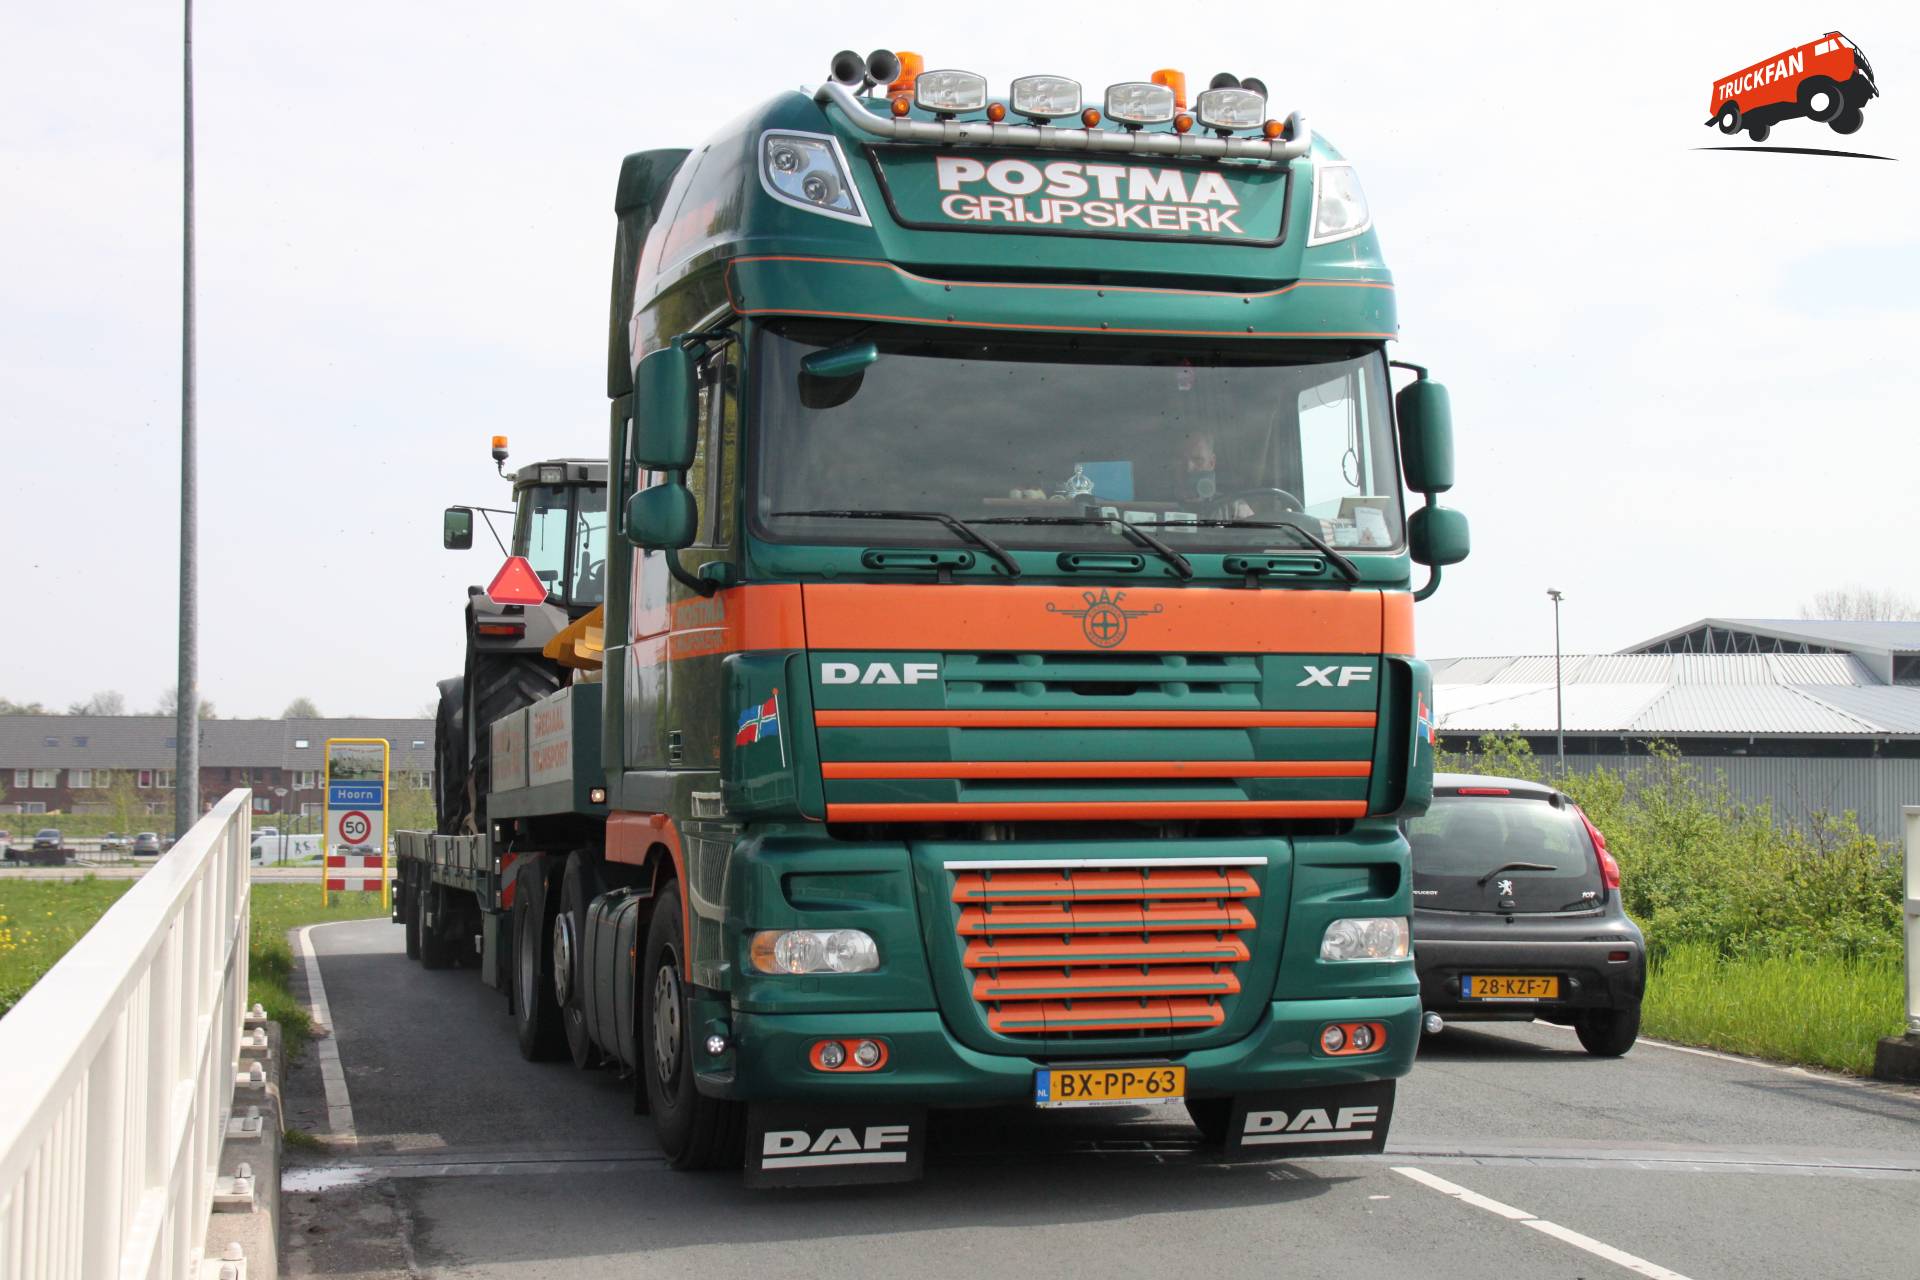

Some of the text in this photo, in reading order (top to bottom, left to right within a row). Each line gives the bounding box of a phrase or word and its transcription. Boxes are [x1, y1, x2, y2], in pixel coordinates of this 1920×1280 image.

[936, 156, 1240, 206] POSTMA
[941, 194, 1243, 233] GRIJPSKERK
[1082, 589, 1127, 606] DAF
[821, 662, 938, 685] DAF
[1295, 665, 1373, 687] XF
[337, 790, 373, 799] Hoorn
[345, 822, 365, 834] 50
[1479, 978, 1551, 994] 28-KZF-7
[1060, 1071, 1176, 1097] BX-PP-63
[1243, 1105, 1379, 1133] DAF
[762, 1125, 910, 1155] DAF
